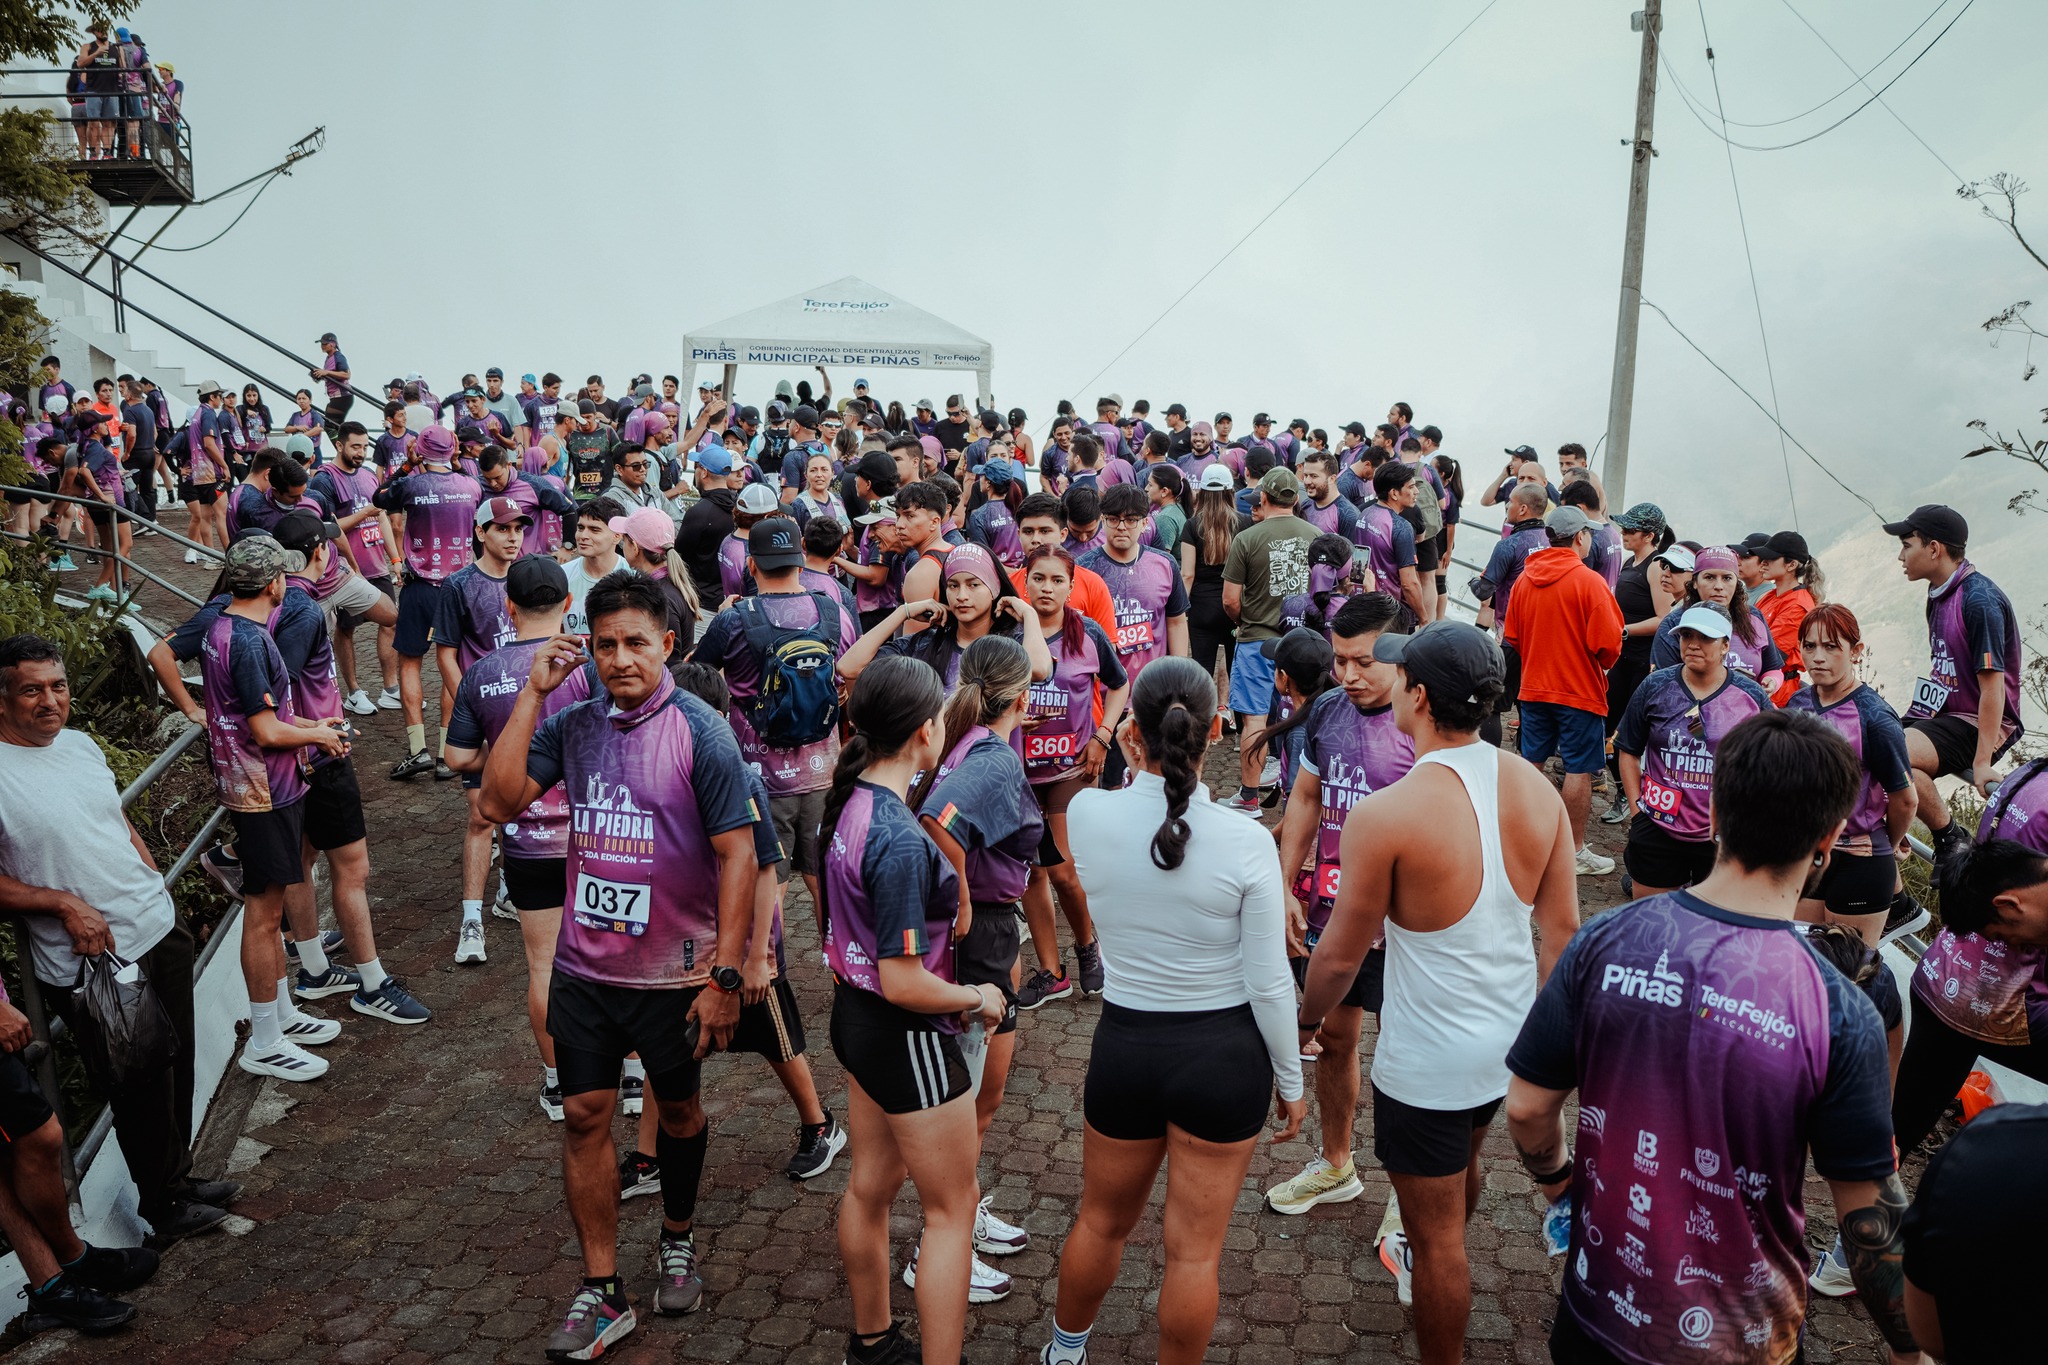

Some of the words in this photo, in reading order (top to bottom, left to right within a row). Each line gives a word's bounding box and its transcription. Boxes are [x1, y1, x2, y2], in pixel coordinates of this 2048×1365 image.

[692, 348, 736, 361] Piñas
[793, 345, 841, 353] AUTÓNOMO
[842, 347, 920, 355] DESCENTRALIZADO
[748, 353, 839, 364] MUNICIPAL
[843, 355, 865, 364] DE
[871, 353, 920, 366] PIÑAS
[582, 474, 598, 482] 627
[414, 495, 440, 505] Piñas
[363, 527, 380, 540] 376
[1117, 625, 1149, 646] 392
[479, 681, 518, 699] Piñas
[1029, 690, 1069, 707] PIEDRA
[1920, 683, 1945, 709] 003
[1030, 736, 1070, 756] 360
[1675, 755, 1714, 774] PIEDR
[1645, 780, 1675, 811] 339
[1681, 782, 1709, 791] EDICIÓN
[574, 809, 589, 834] LA
[595, 811, 654, 840] PIEDRA
[1326, 821, 1342, 831] 2DA
[574, 833, 598, 849] TRAIL
[604, 837, 654, 855] RUNNING
[584, 850, 599, 860] 2DA
[601, 852, 637, 864] EDICIÓN
[584, 881, 641, 917] 037
[613, 921, 626, 933] 12K
[1601, 963, 1683, 1008] Piñas
[1713, 1014, 1785, 1050] ALCALDESA
[1633, 1152, 1659, 1170] BENYI
[1633, 1162, 1657, 1177] SOUND
[1680, 1167, 1735, 1200] PREVENSUR
[1616, 1246, 1653, 1278] BOLIVAR
[1683, 1266, 1724, 1284] CHAVAL
[1607, 1289, 1652, 1325] ANANAS
[1614, 1303, 1641, 1328] CLUB
